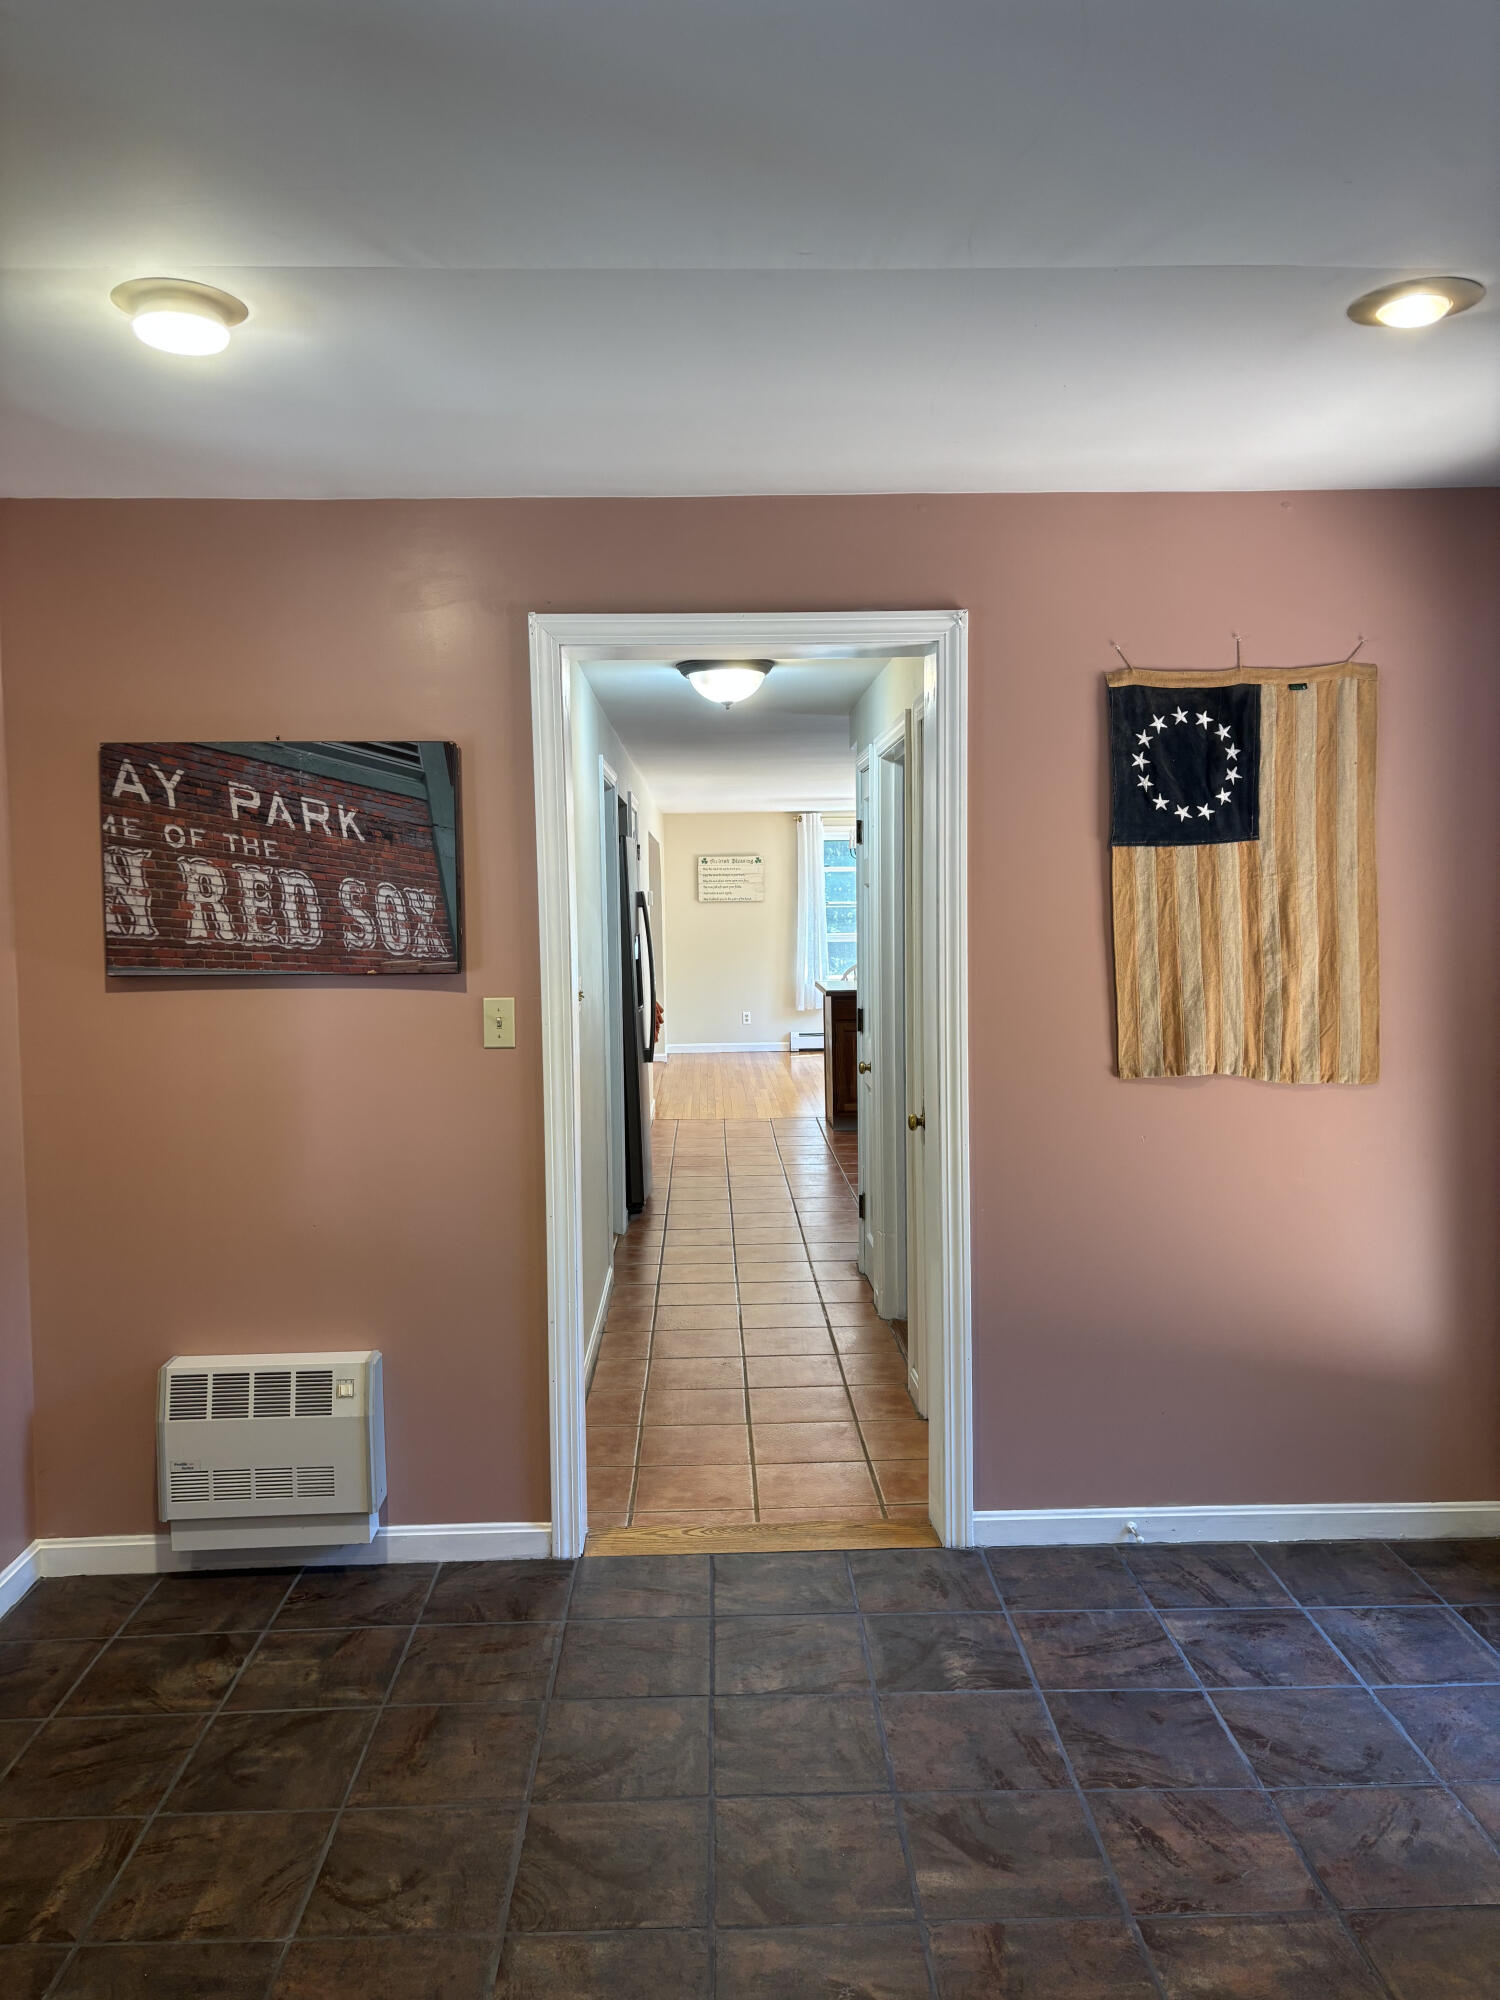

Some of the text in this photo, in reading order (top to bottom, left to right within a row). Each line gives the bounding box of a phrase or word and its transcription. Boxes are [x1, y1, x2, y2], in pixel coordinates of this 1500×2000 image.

[112, 758, 366, 843] AY PARK
[163, 823, 206, 849] OF
[223, 833, 280, 860] THE
[177, 857, 324, 951] RED
[339, 878, 451, 958] SOX
